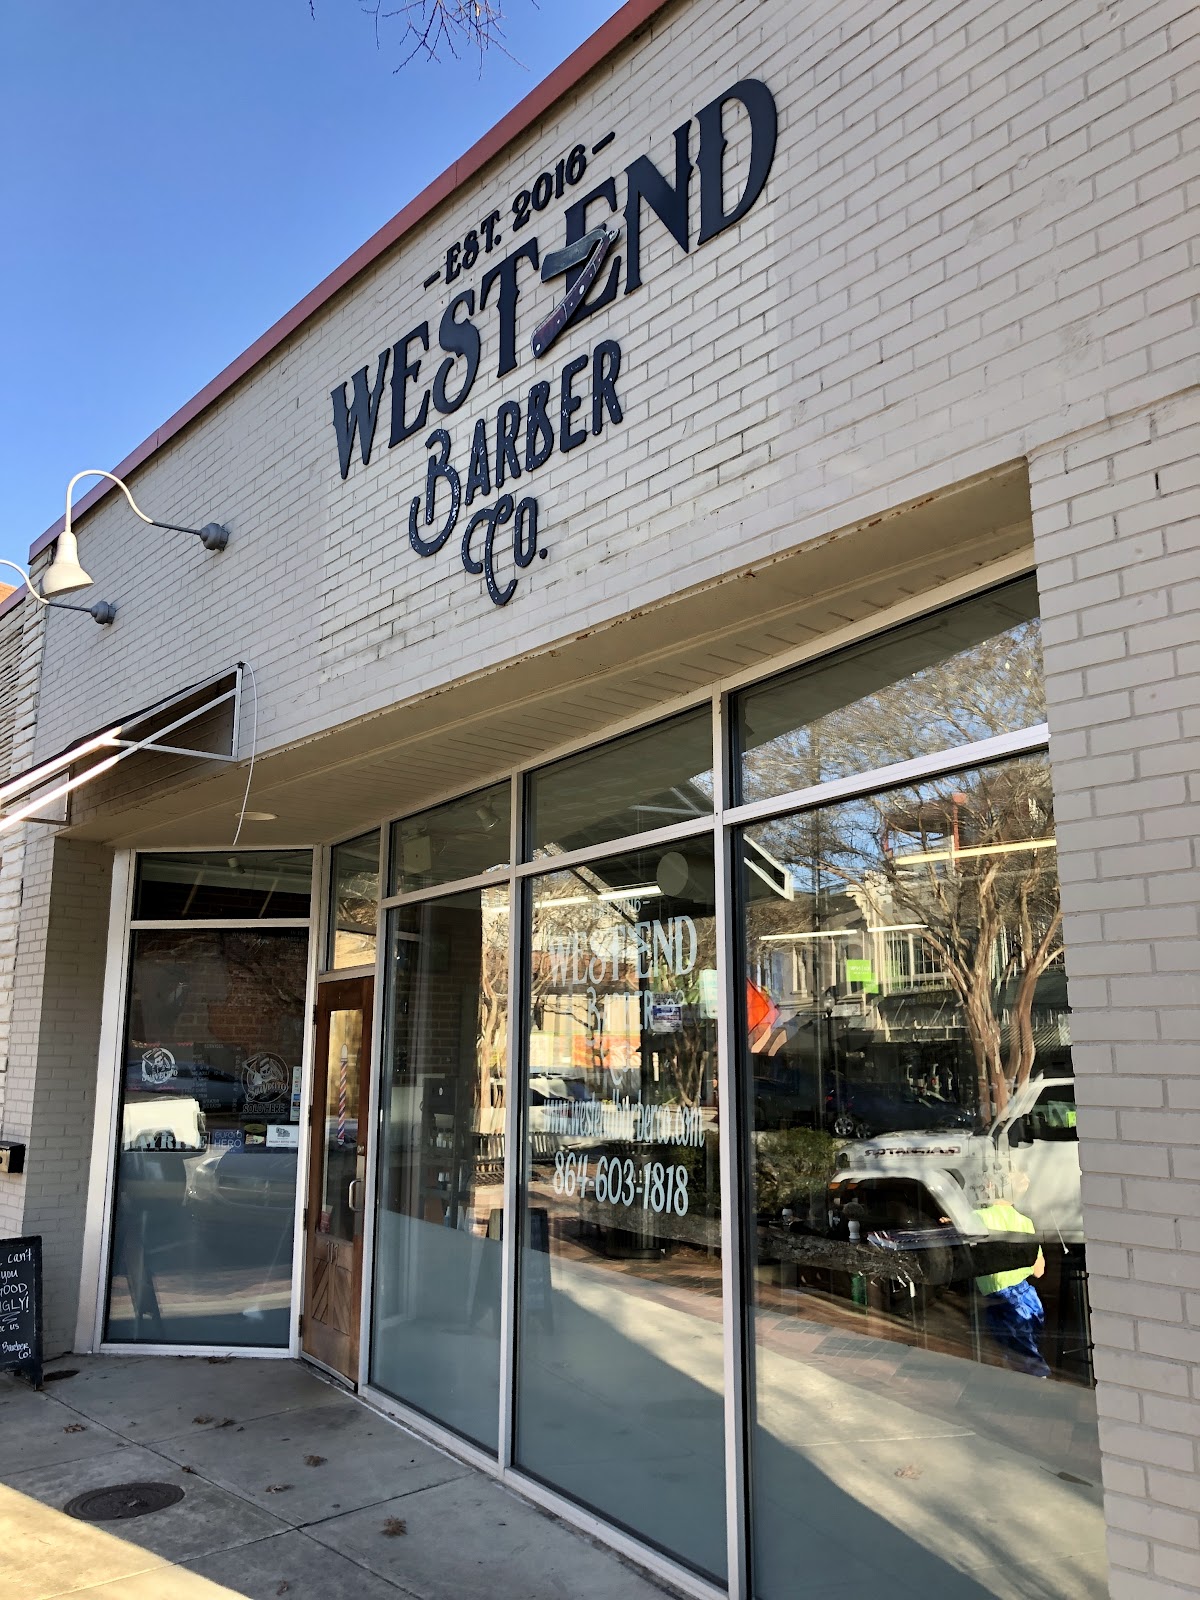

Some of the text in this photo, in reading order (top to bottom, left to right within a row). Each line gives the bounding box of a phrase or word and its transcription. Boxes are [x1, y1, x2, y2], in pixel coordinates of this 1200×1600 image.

[330, 78, 777, 480] WEST END
[408, 339, 624, 557] BARBER
[634, 915, 698, 979] END
[263, 1103, 285, 1114] HERE
[214, 1139, 242, 1148] HERO
[553, 1151, 689, 1217] 864-603-1818
[0, 1269, 19, 1285] you
